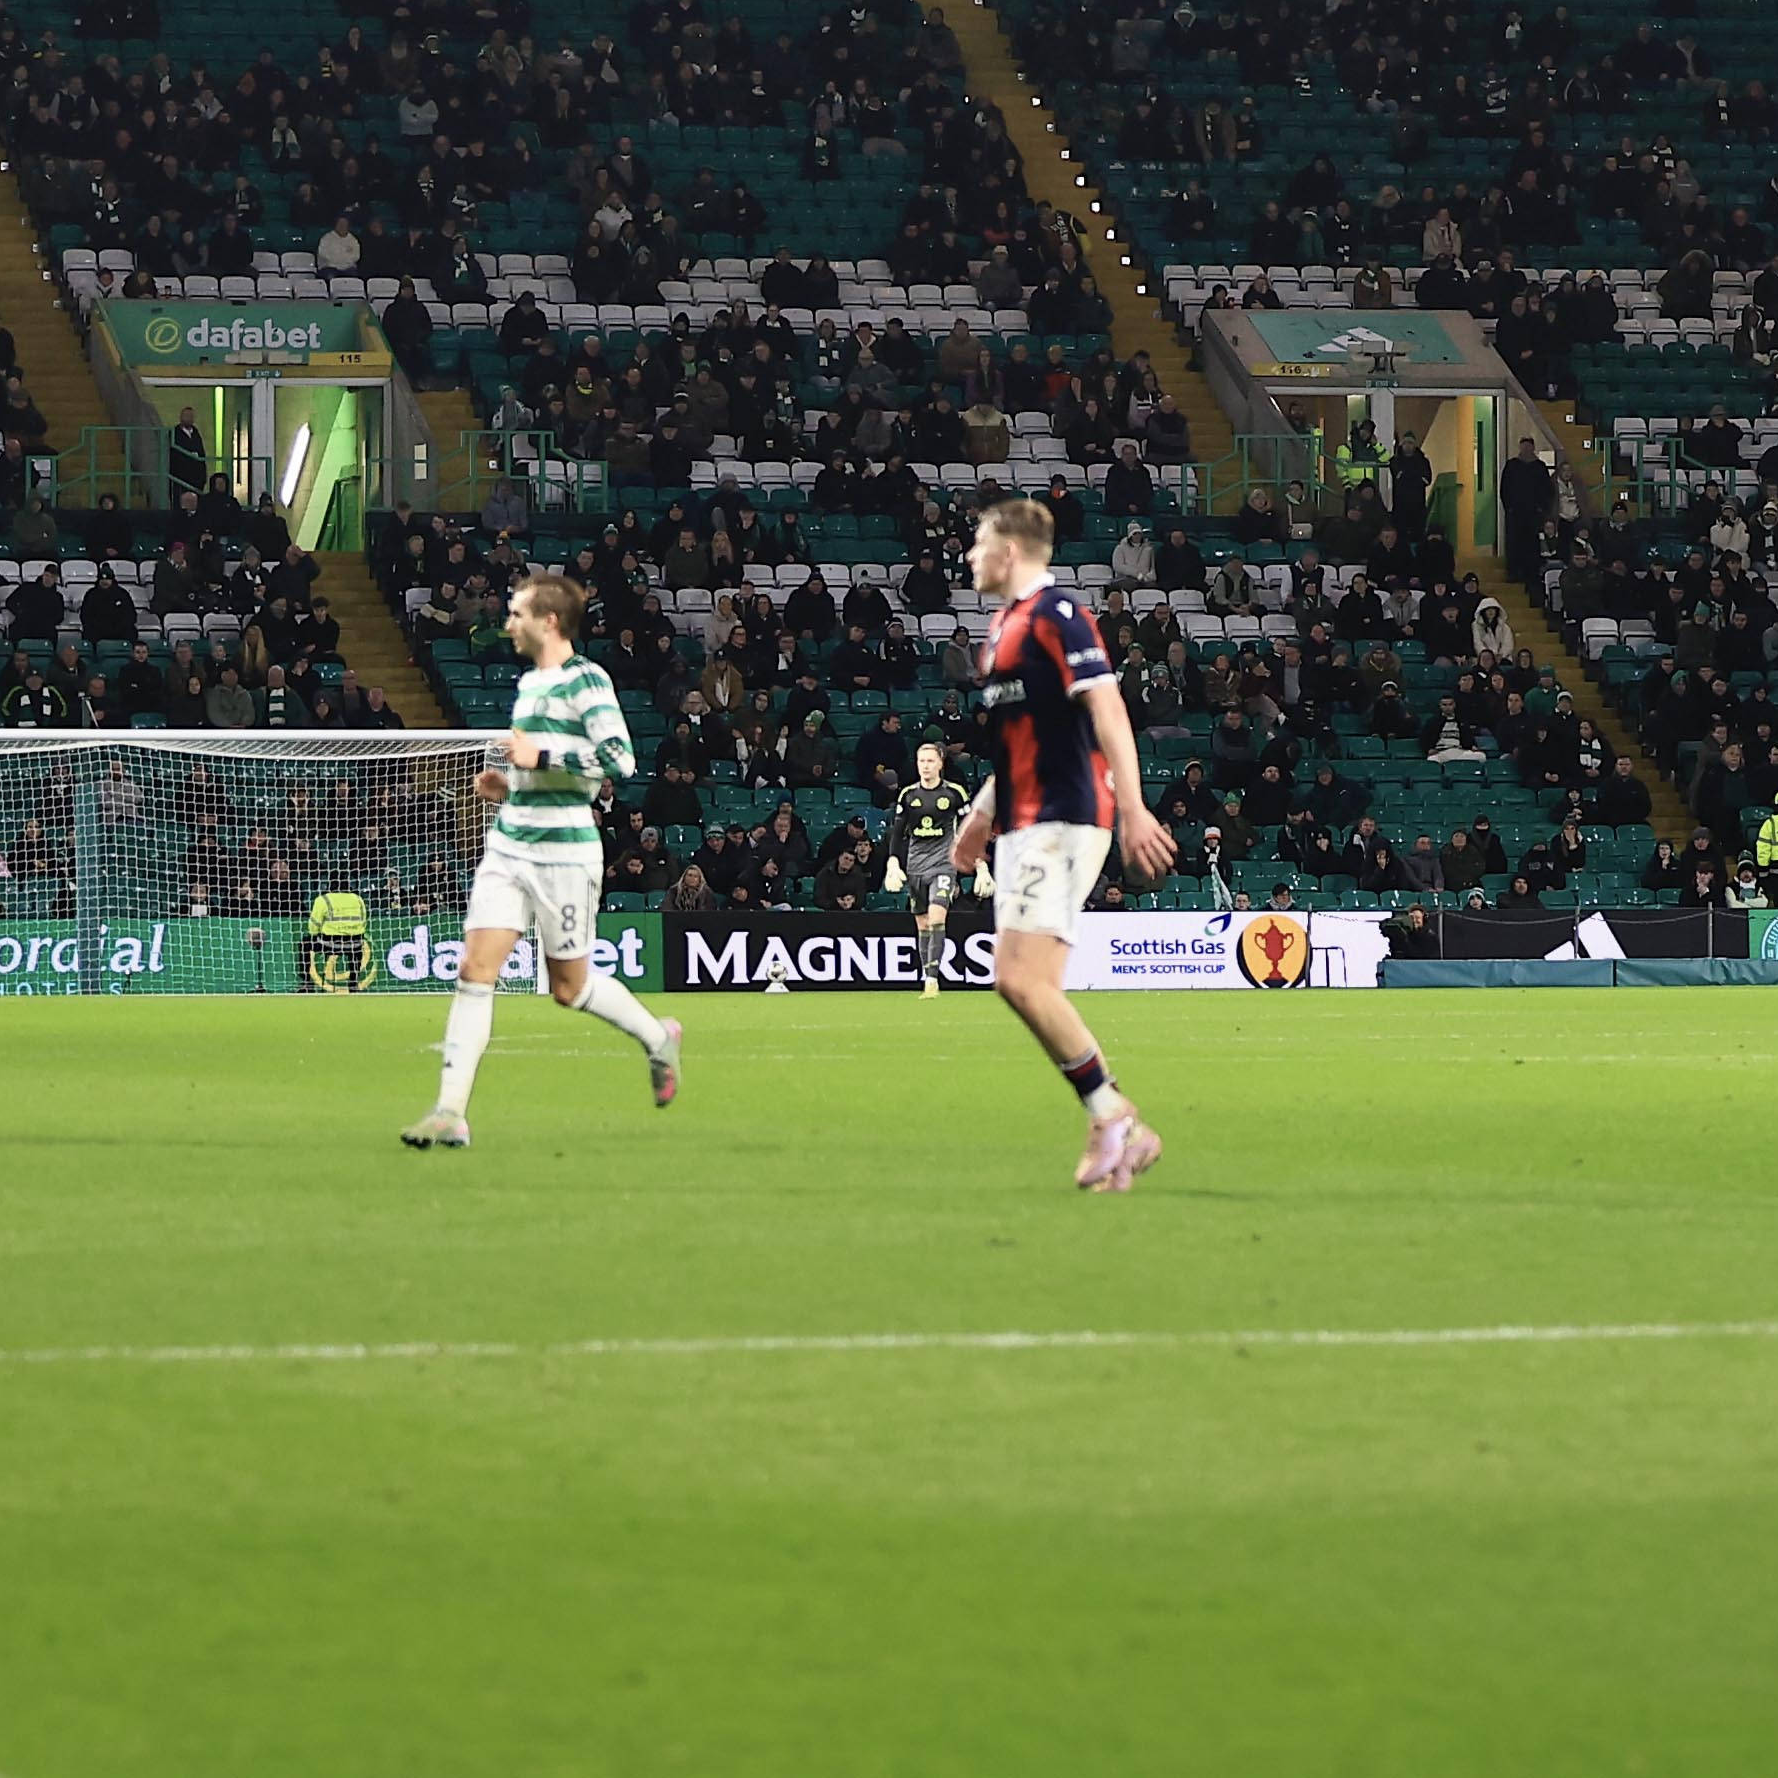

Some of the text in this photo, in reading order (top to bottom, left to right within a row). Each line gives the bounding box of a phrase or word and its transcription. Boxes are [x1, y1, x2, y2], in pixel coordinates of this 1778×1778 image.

[186, 318, 322, 351] dafabet
[339, 353, 362, 364] 115
[561, 904, 577, 932] 8
[387, 924, 645, 982] daaet
[1110, 938, 1226, 956] Scottish Gas
[1112, 964, 1226, 975] MEN'S SCOTTISH CUP
